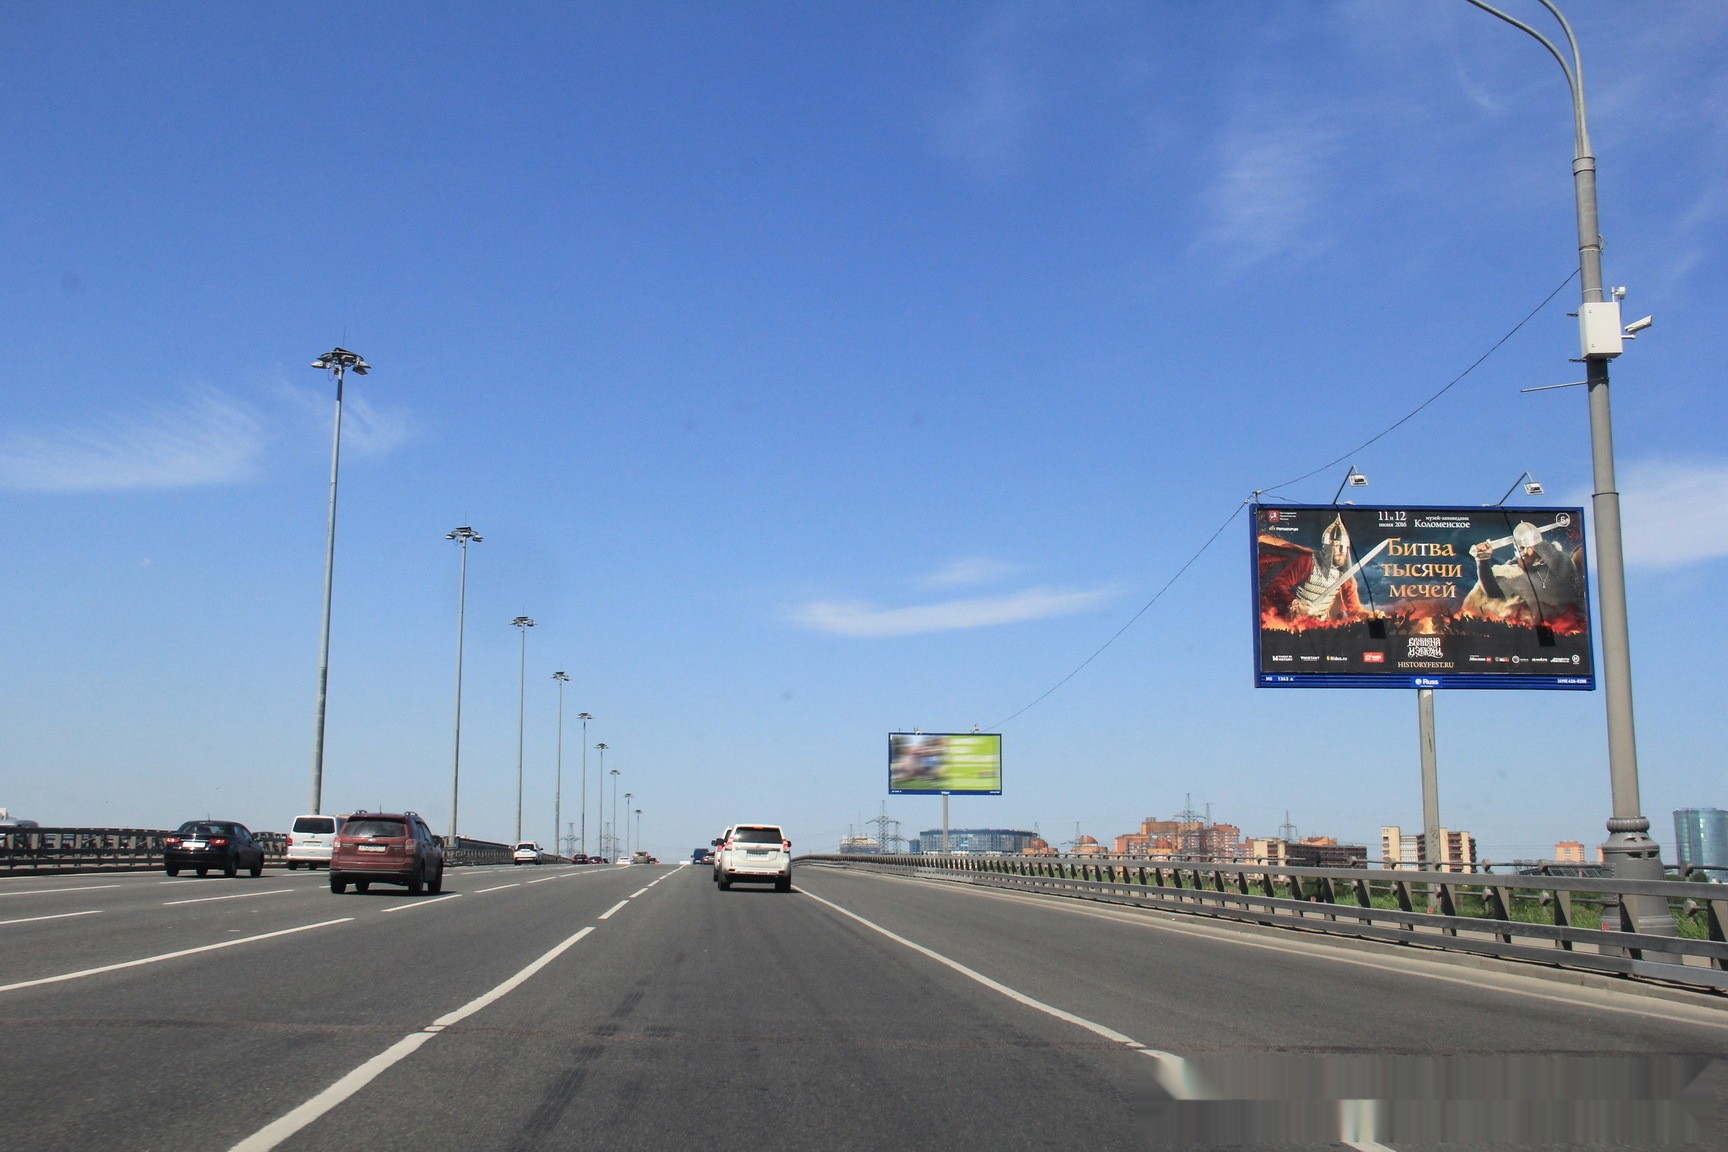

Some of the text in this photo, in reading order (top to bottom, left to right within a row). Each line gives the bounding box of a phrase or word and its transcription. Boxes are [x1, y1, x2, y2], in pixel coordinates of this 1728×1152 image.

[1378, 511, 1389, 521] 11
[1395, 511, 1407, 521] 12
[1388, 537, 1457, 556] Битва
[1381, 563, 1463, 578] тысячи
[1389, 581, 1457, 598] мечей
[1397, 661, 1455, 669] HISTORYFEST.RU
